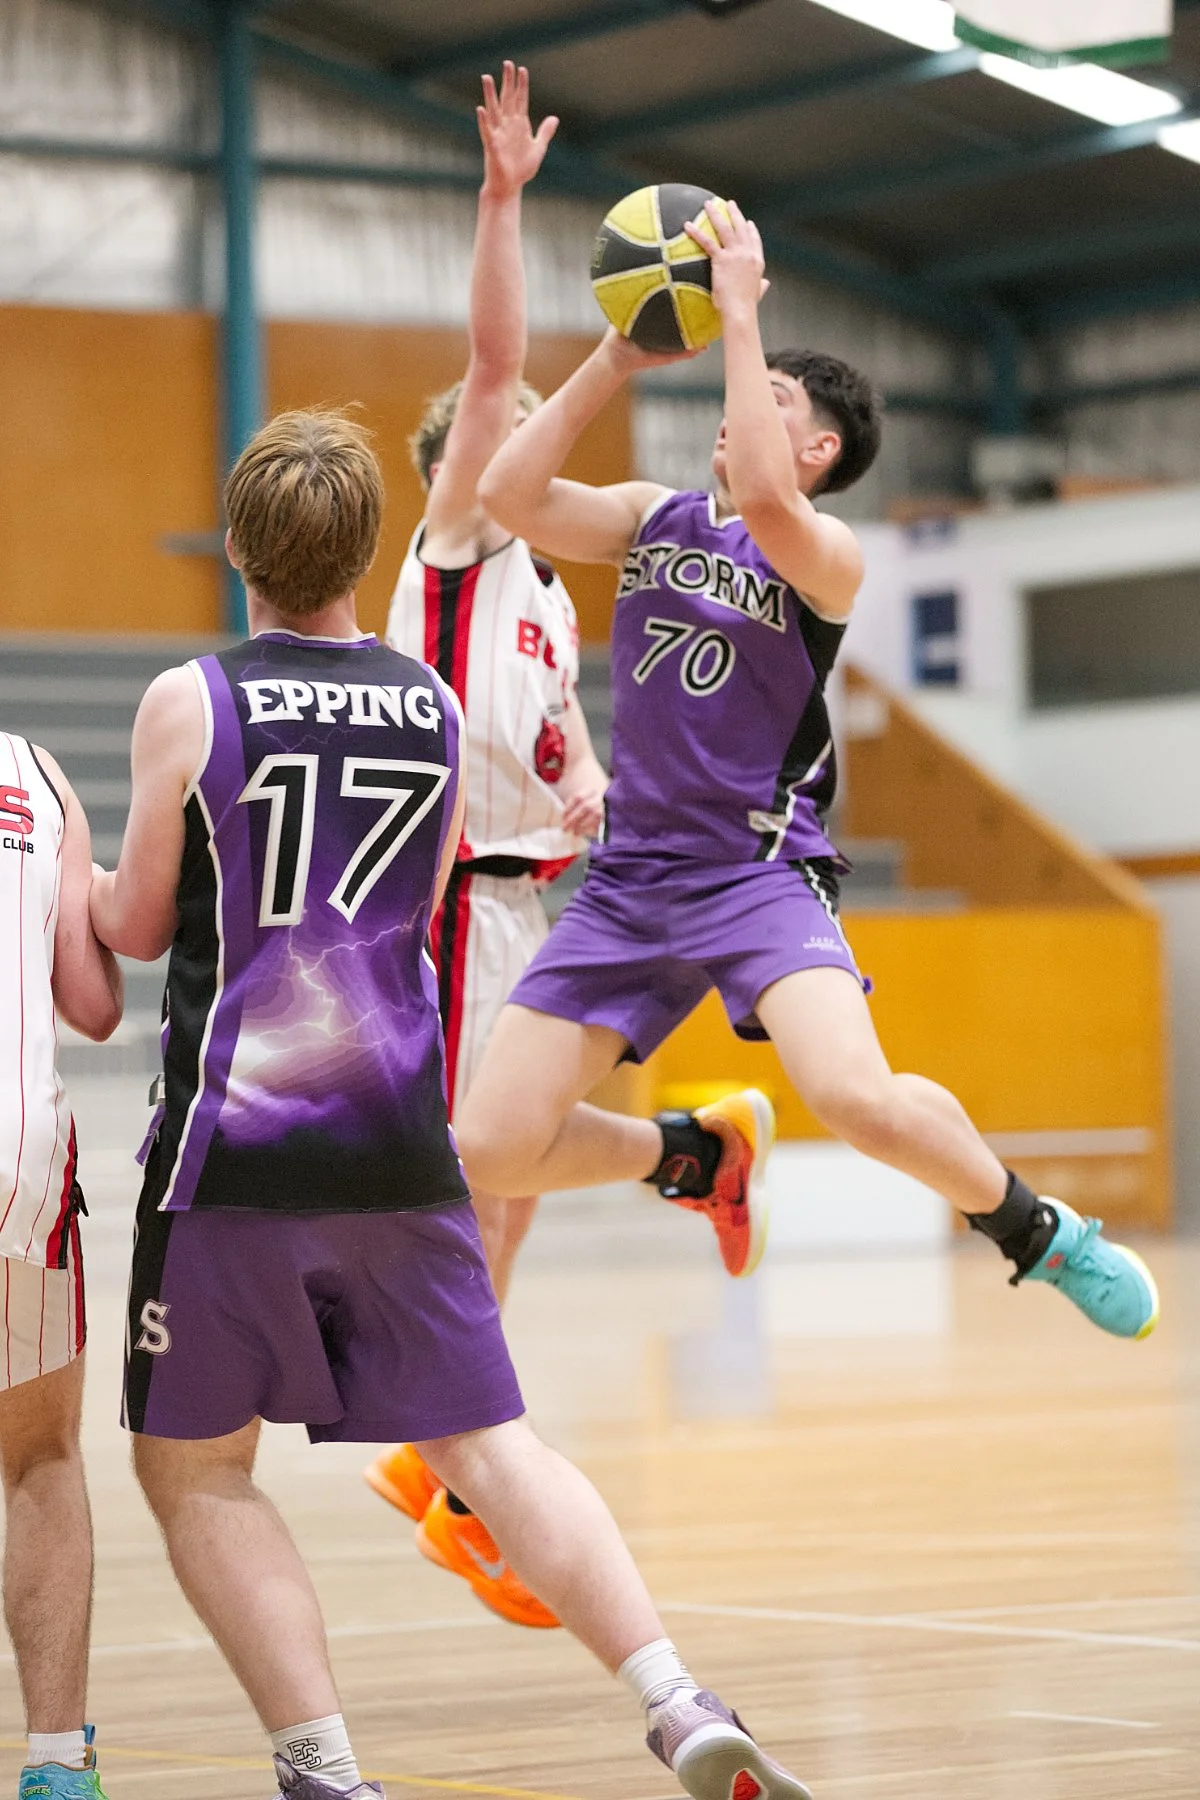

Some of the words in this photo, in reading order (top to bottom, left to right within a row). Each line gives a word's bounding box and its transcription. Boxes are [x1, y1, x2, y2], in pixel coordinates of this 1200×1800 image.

[616, 541, 787, 634] STORM
[632, 616, 736, 697] 70
[237, 679, 442, 733] EPPING
[3, 837, 35, 854] CLUB
[236, 753, 452, 928] 17
[133, 1298, 172, 1356] S
[287, 1738, 321, 1769] EC
